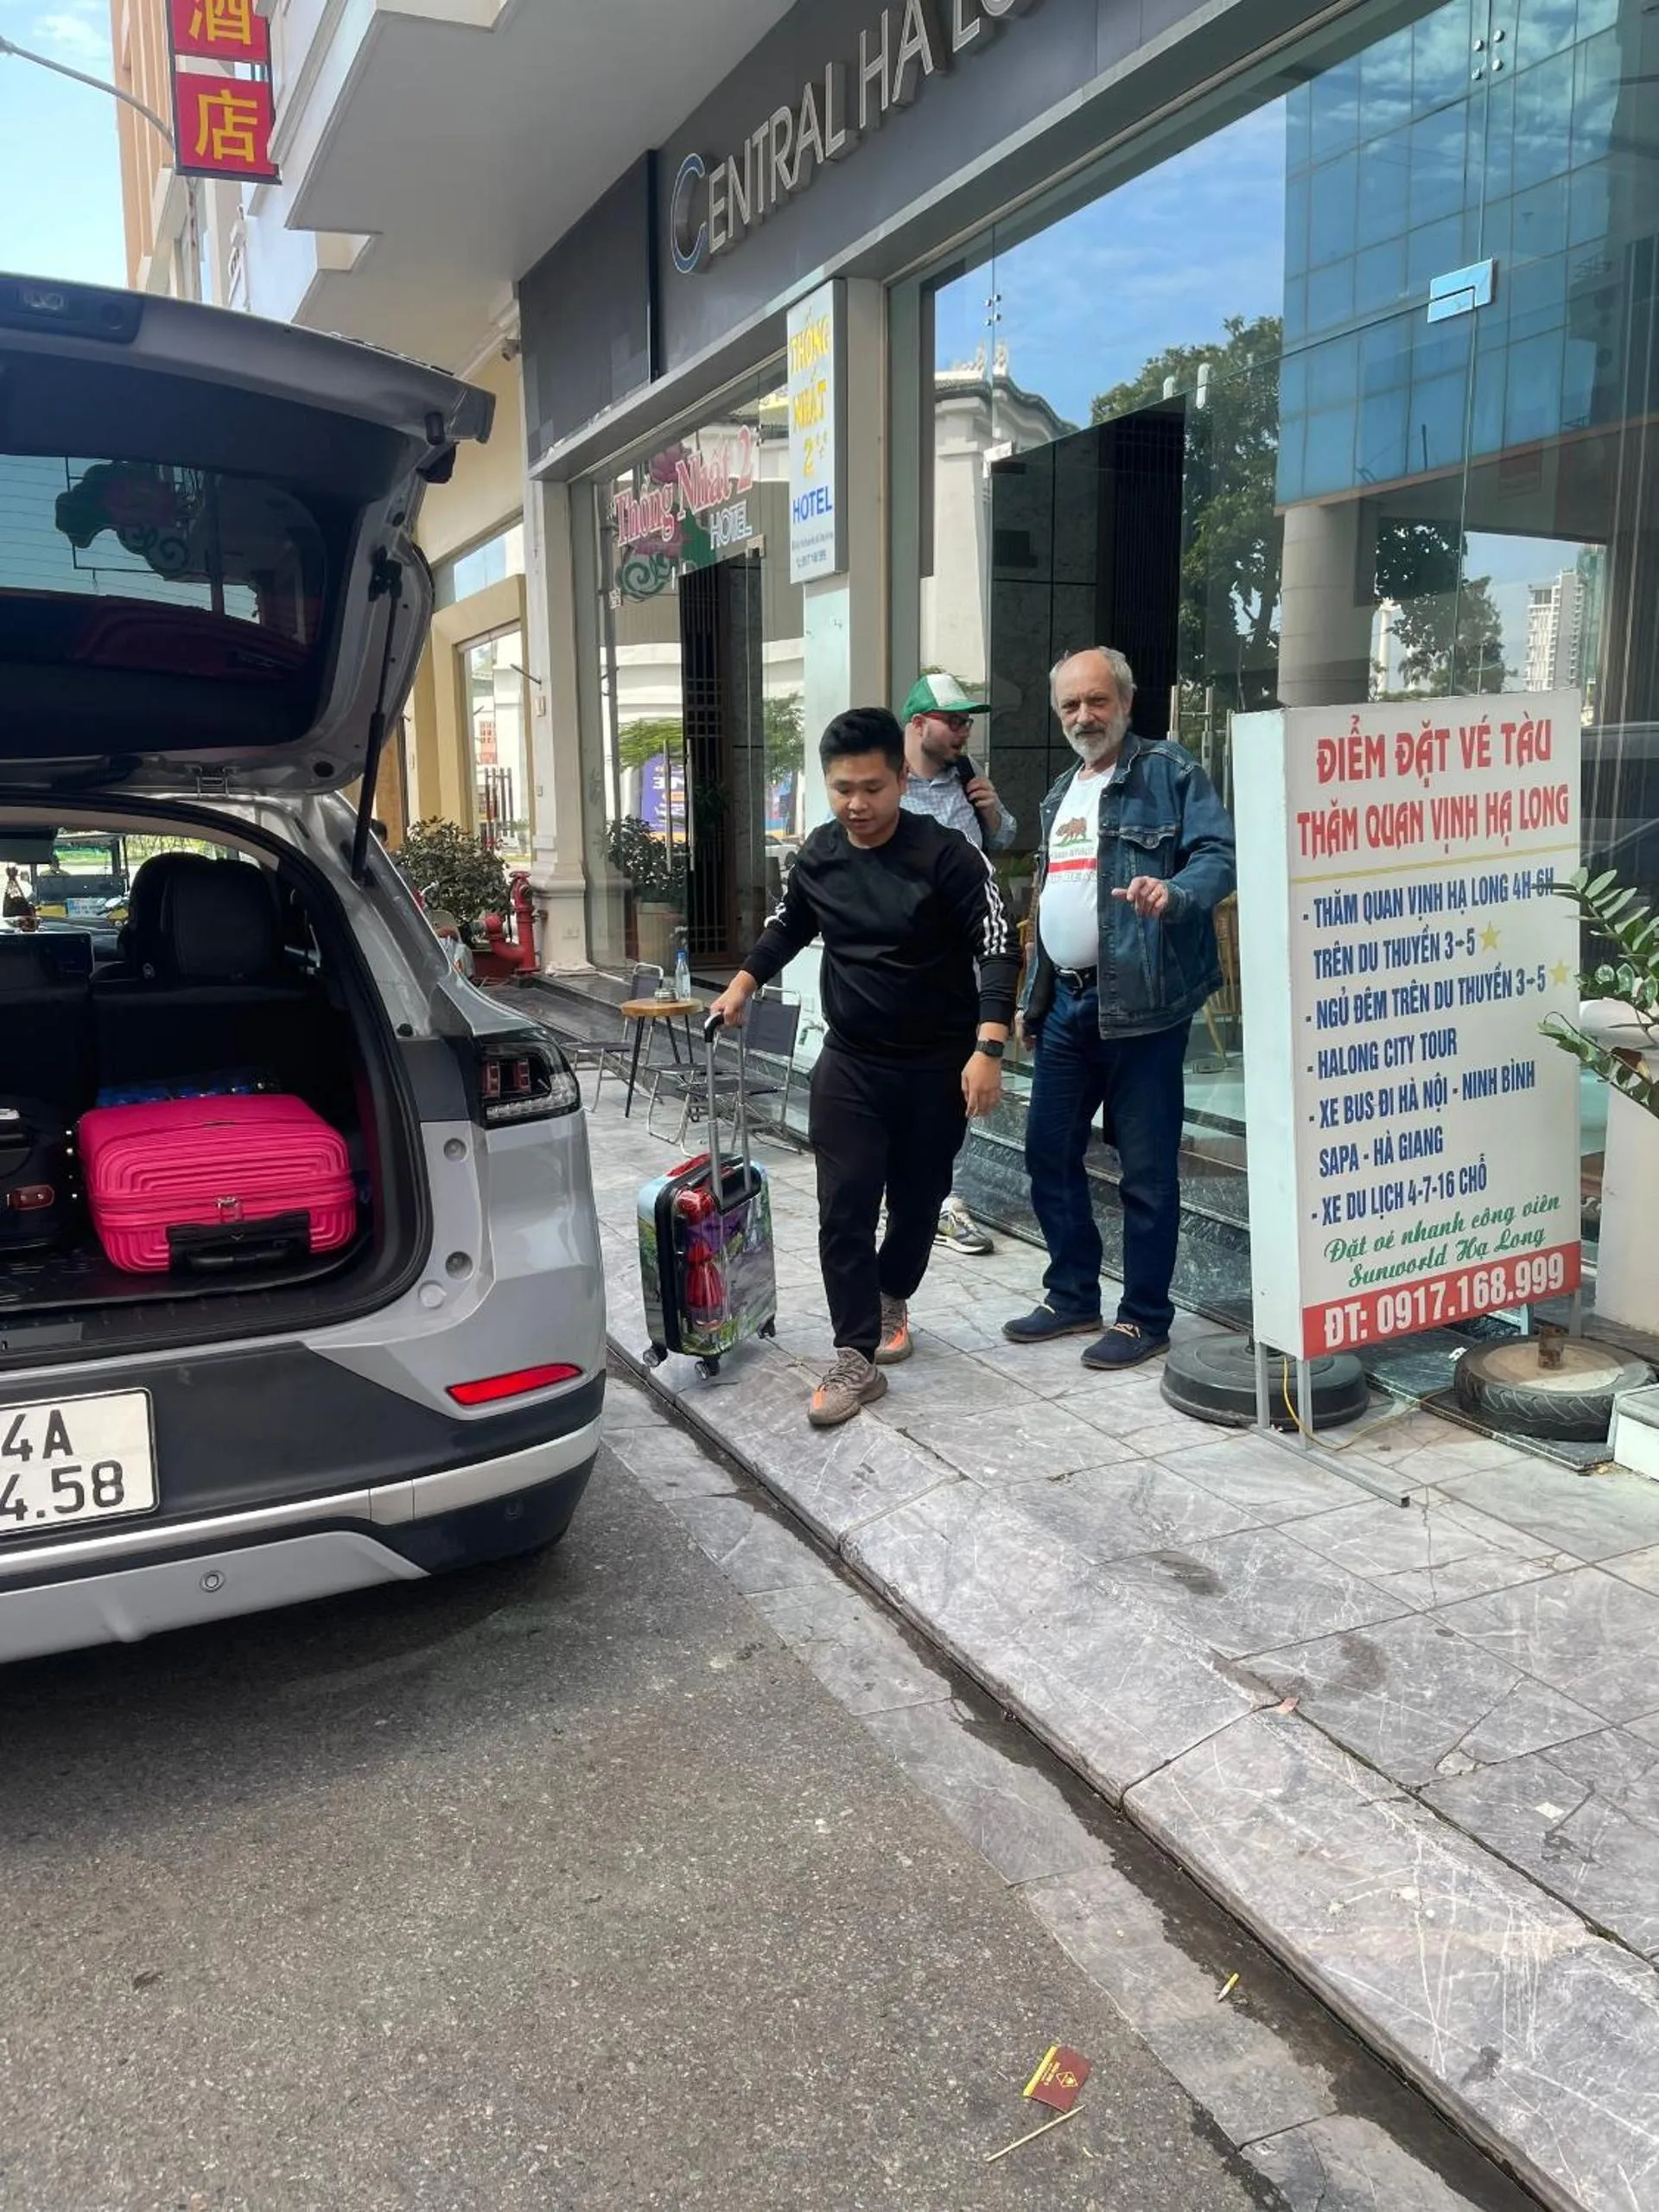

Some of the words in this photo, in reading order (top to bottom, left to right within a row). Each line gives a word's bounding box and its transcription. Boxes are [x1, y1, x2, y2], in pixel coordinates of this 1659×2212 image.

[671, 61, 847, 274] CENTRAL
[736, 424, 753, 494] 2
[709, 499, 753, 550] HOTEL
[792, 486, 833, 524] HOTEL
[1317, 715, 1386, 784] ĐIỂM
[1395, 720, 1451, 787] ĐẶT
[1459, 715, 1492, 769] VÉ
[1501, 711, 1553, 768] TÀU
[1297, 800, 1358, 860] THĂM
[1366, 799, 1424, 849] QUAN
[1430, 793, 1478, 854] VỊNH
[1486, 790, 1513, 847] HẠ
[1519, 784, 1569, 830] LONG
[1313, 888, 1358, 928] THĂM
[1363, 887, 1403, 925] QUAN
[1408, 882, 1443, 921] VỊNH
[1447, 879, 1467, 915] HẠ
[1471, 874, 1509, 906] LONG
[1313, 940, 1354, 980] TRÊN
[1358, 942, 1378, 973] DU
[1316, 986, 1349, 1030] NGỦ
[1354, 986, 1387, 1024] ĐÊM
[1392, 979, 1430, 1017] TRÊN
[1434, 979, 1453, 1011] DU
[1318, 1040, 1379, 1079] HALONG
[1383, 1034, 1415, 1068] CITY
[1420, 1027, 1458, 1061] TOUR
[1319, 1097, 1339, 1128] XE
[1344, 1090, 1375, 1124] BUS
[1379, 1087, 1394, 1117] ĐI
[1399, 1077, 1419, 1114] HÀ
[1423, 1071, 1448, 1112] NỘI
[1462, 1067, 1497, 1101] NINH
[1501, 1058, 1535, 1093] BÌNH
[1319, 1143, 1359, 1177] SAPA
[1374, 1130, 1395, 1166] HÀ
[1399, 1125, 1444, 1161] GIANG
[1322, 1194, 1341, 1226] XE
[1346, 1189, 1367, 1220] DU
[1371, 1180, 1404, 1220] LỊCH
[1408, 1170, 1455, 1205] 4-7-16
[1459, 1153, 1487, 1195] CHỖ
[1324, 1236, 1368, 1263] Đặt
[1374, 1233, 1395, 1251] vé
[1401, 1211, 1467, 1246] nhanh
[1471, 1203, 1516, 1227] công
[1522, 1194, 1561, 1217] viên
[1349, 1243, 1448, 1287] Sunworld
[1456, 1236, 1488, 1262] Hạ
[1494, 1227, 1547, 1251] Long
[1324, 1302, 1368, 1348] ĐT:
[1376, 1253, 1564, 1334] 0917.168.999
